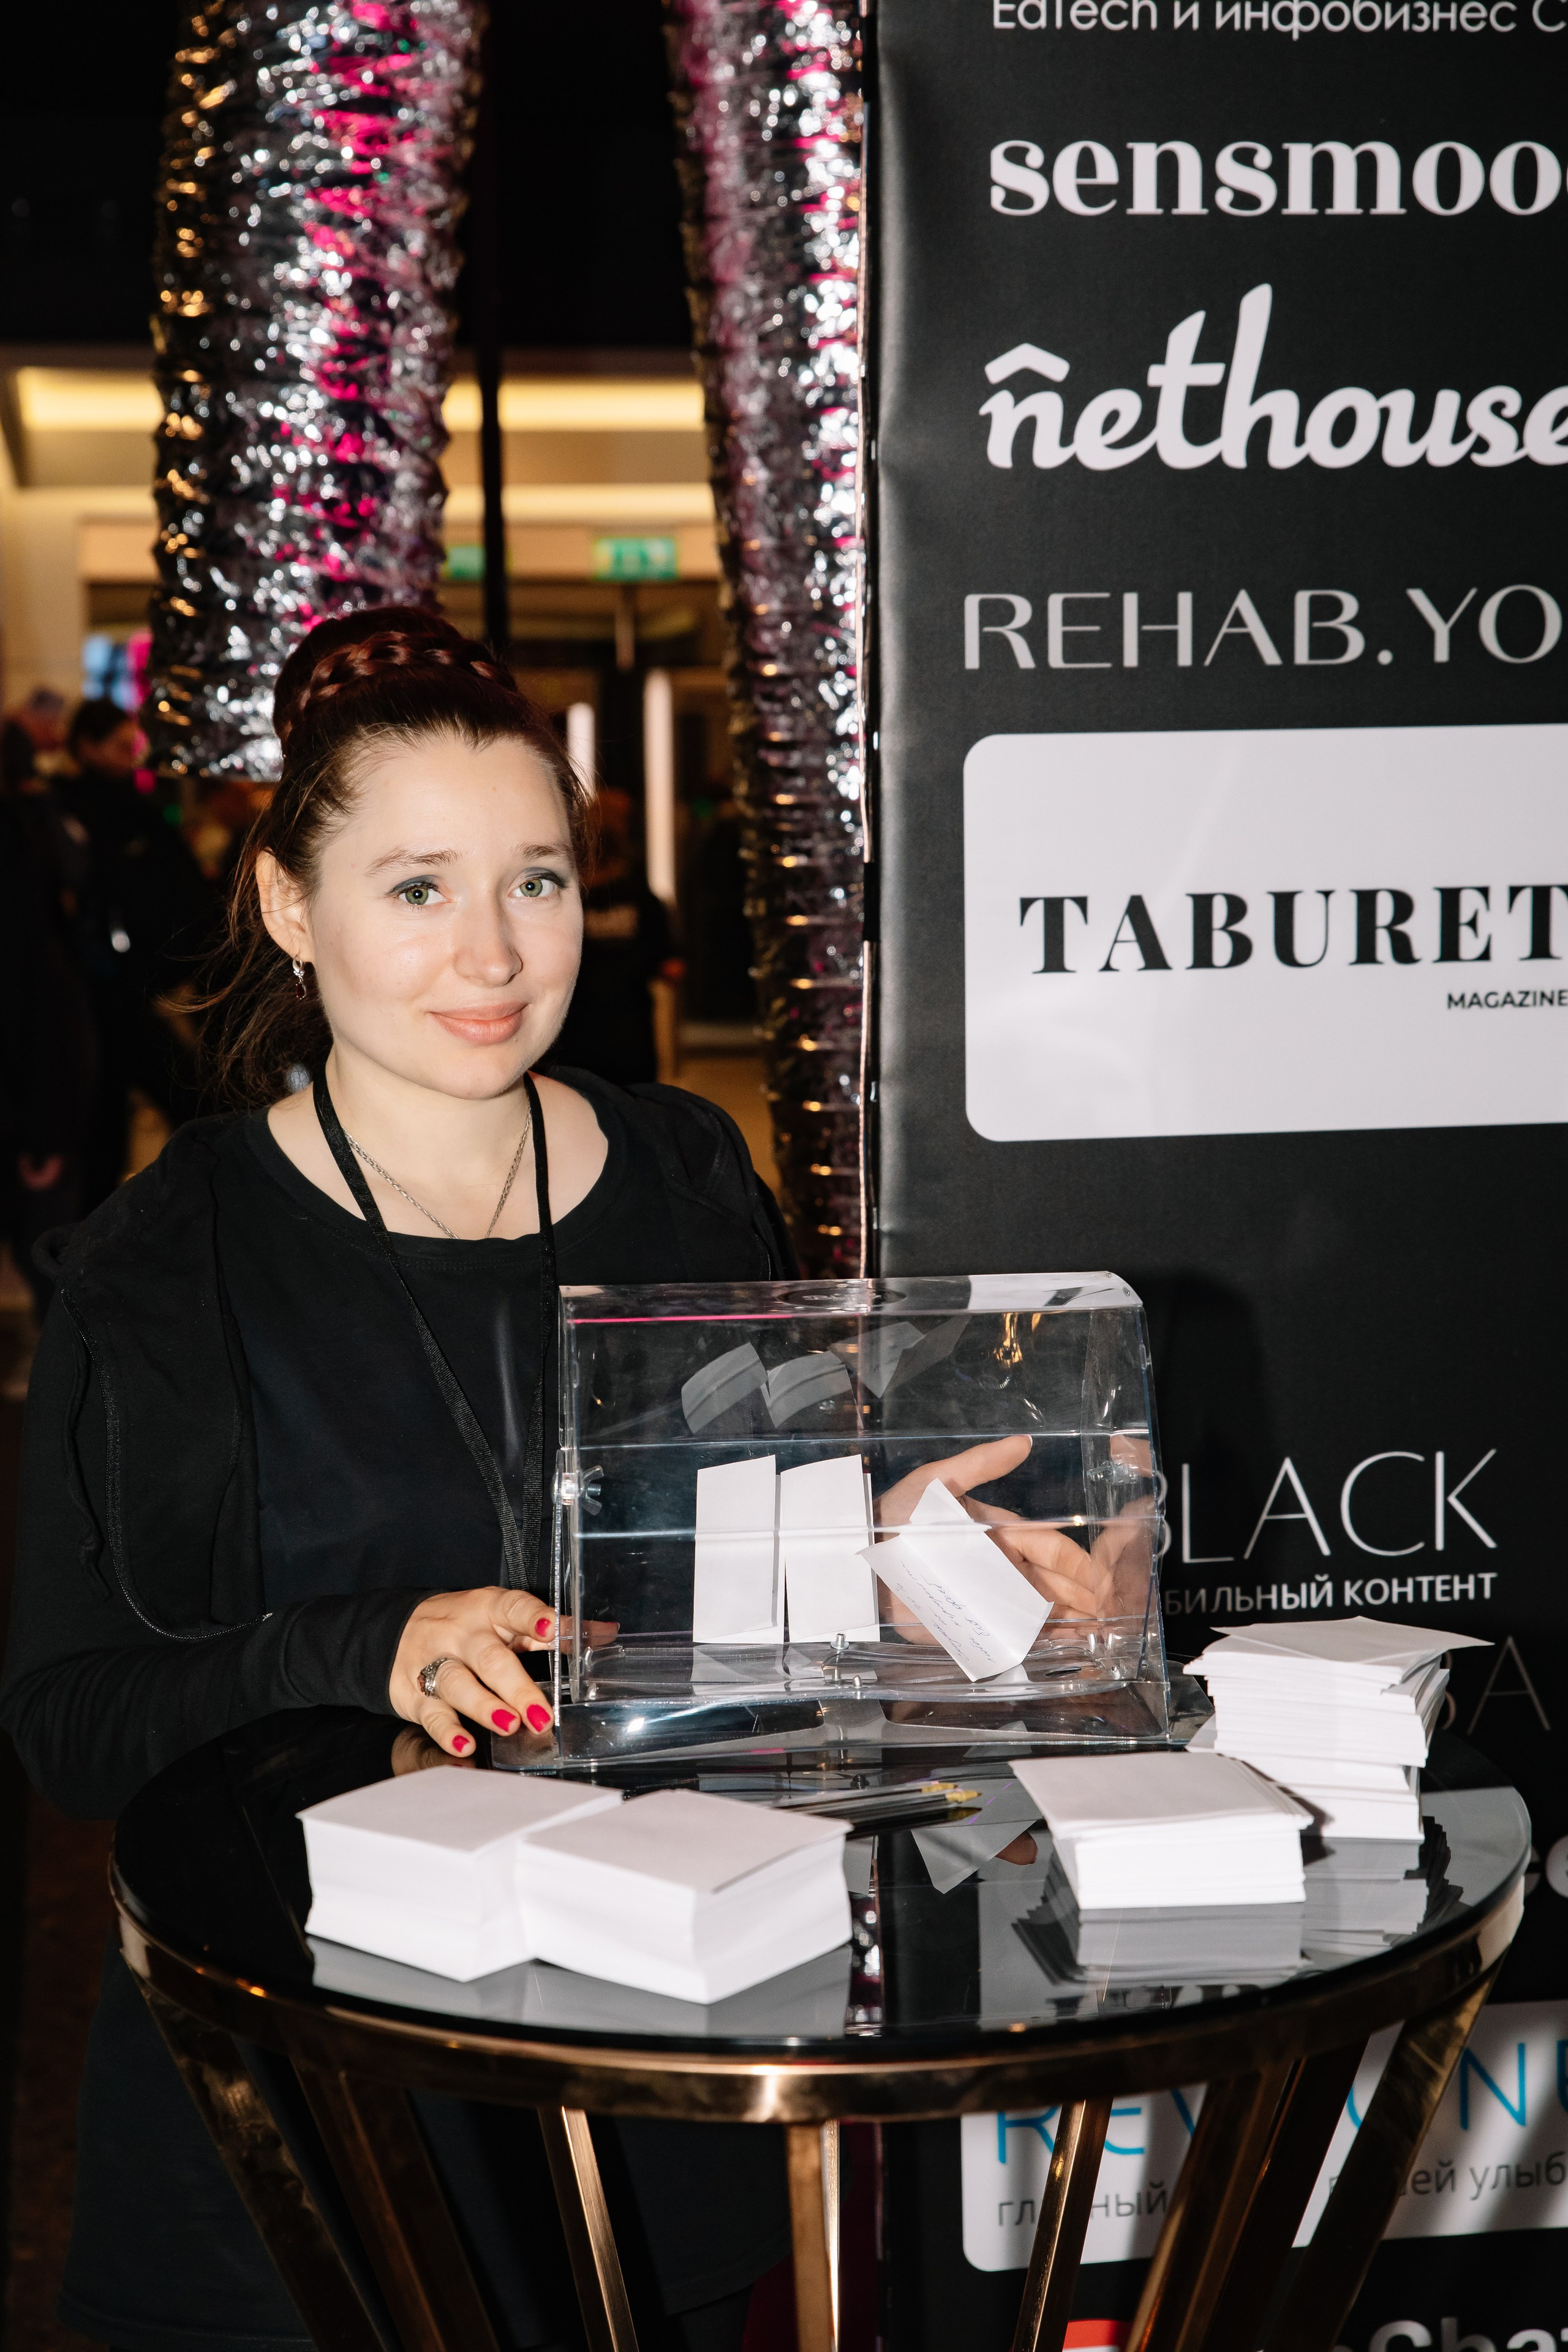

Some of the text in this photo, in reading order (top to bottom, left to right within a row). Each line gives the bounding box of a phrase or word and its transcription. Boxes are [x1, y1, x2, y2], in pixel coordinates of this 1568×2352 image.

[1174, 0, 1199, 31] и
[990, 140, 1568, 217] sensmoo
[1019, 883, 1568, 974] TABURET
[1447, 988, 1568, 1010] MAGAZINE
[1164, 1572, 1499, 1616] БИЛЬНЫЙ КОНТЕНТ
[998, 2180, 1167, 2227] глный
